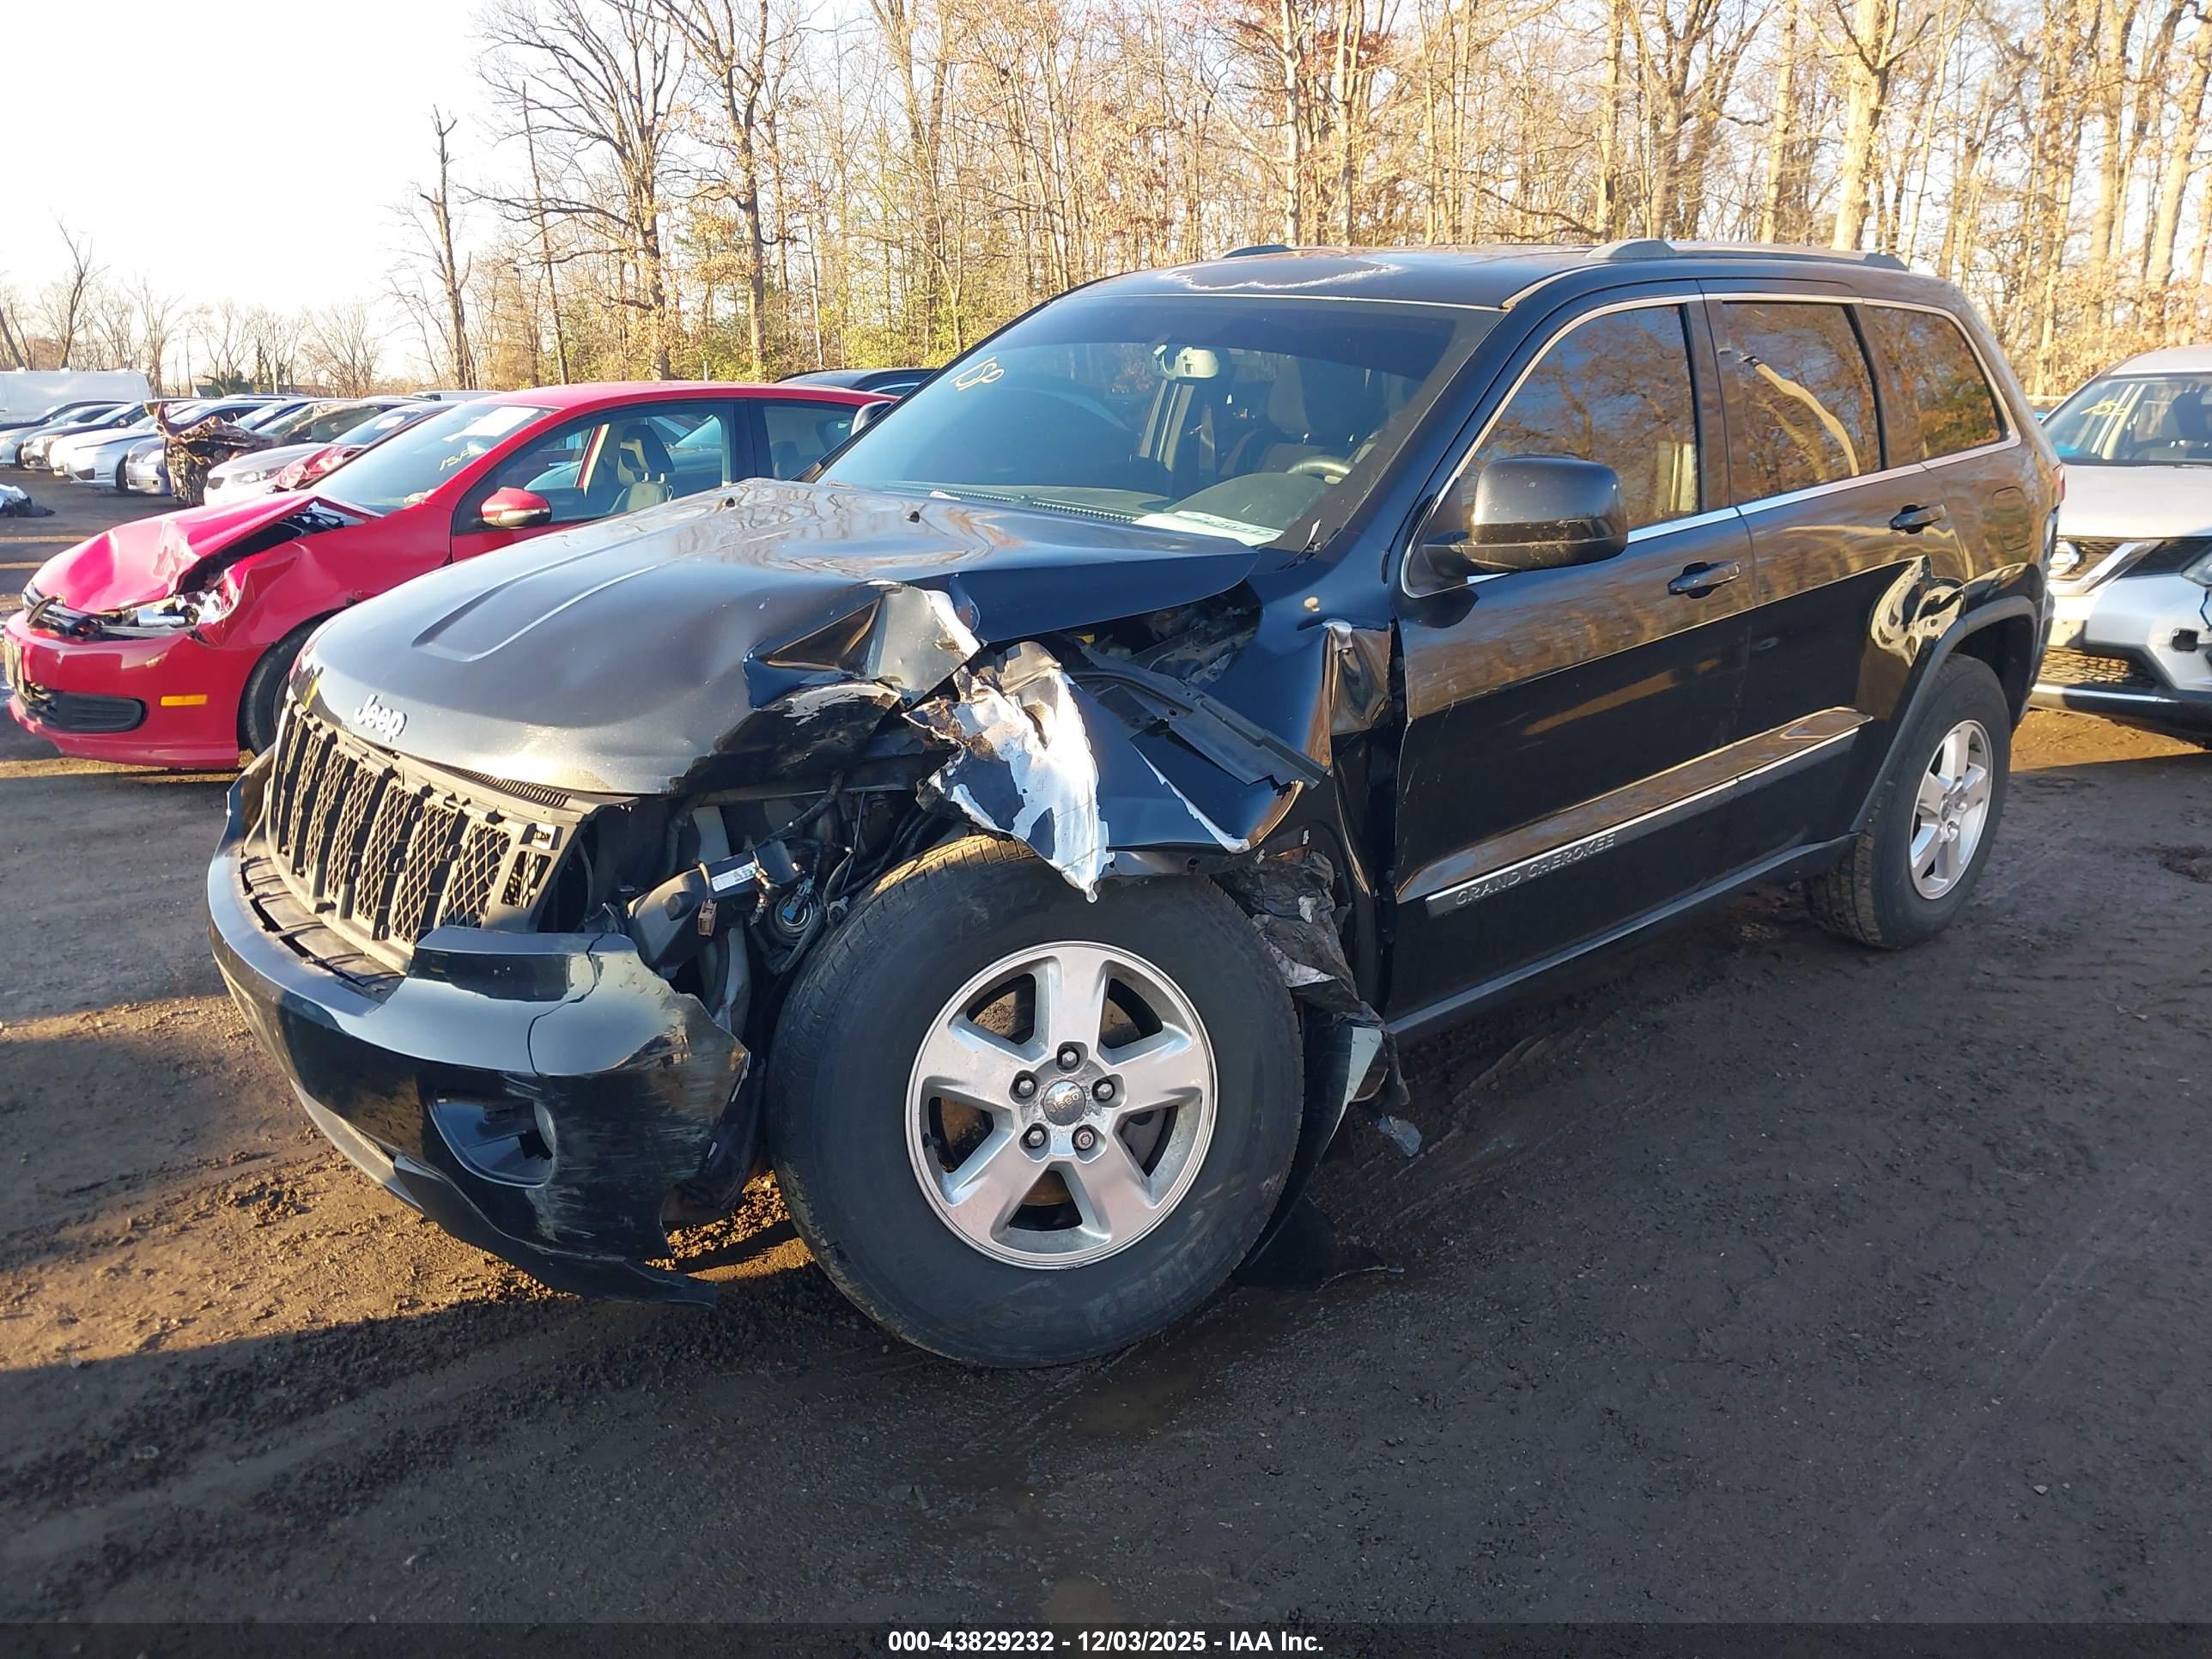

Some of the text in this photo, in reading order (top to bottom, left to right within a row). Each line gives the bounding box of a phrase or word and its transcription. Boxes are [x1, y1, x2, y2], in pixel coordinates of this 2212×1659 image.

[353, 692, 408, 743] Jeep
[1455, 833, 1616, 906] GRAND CHEROKEE
[1049, 1091, 1080, 1114] Jeep
